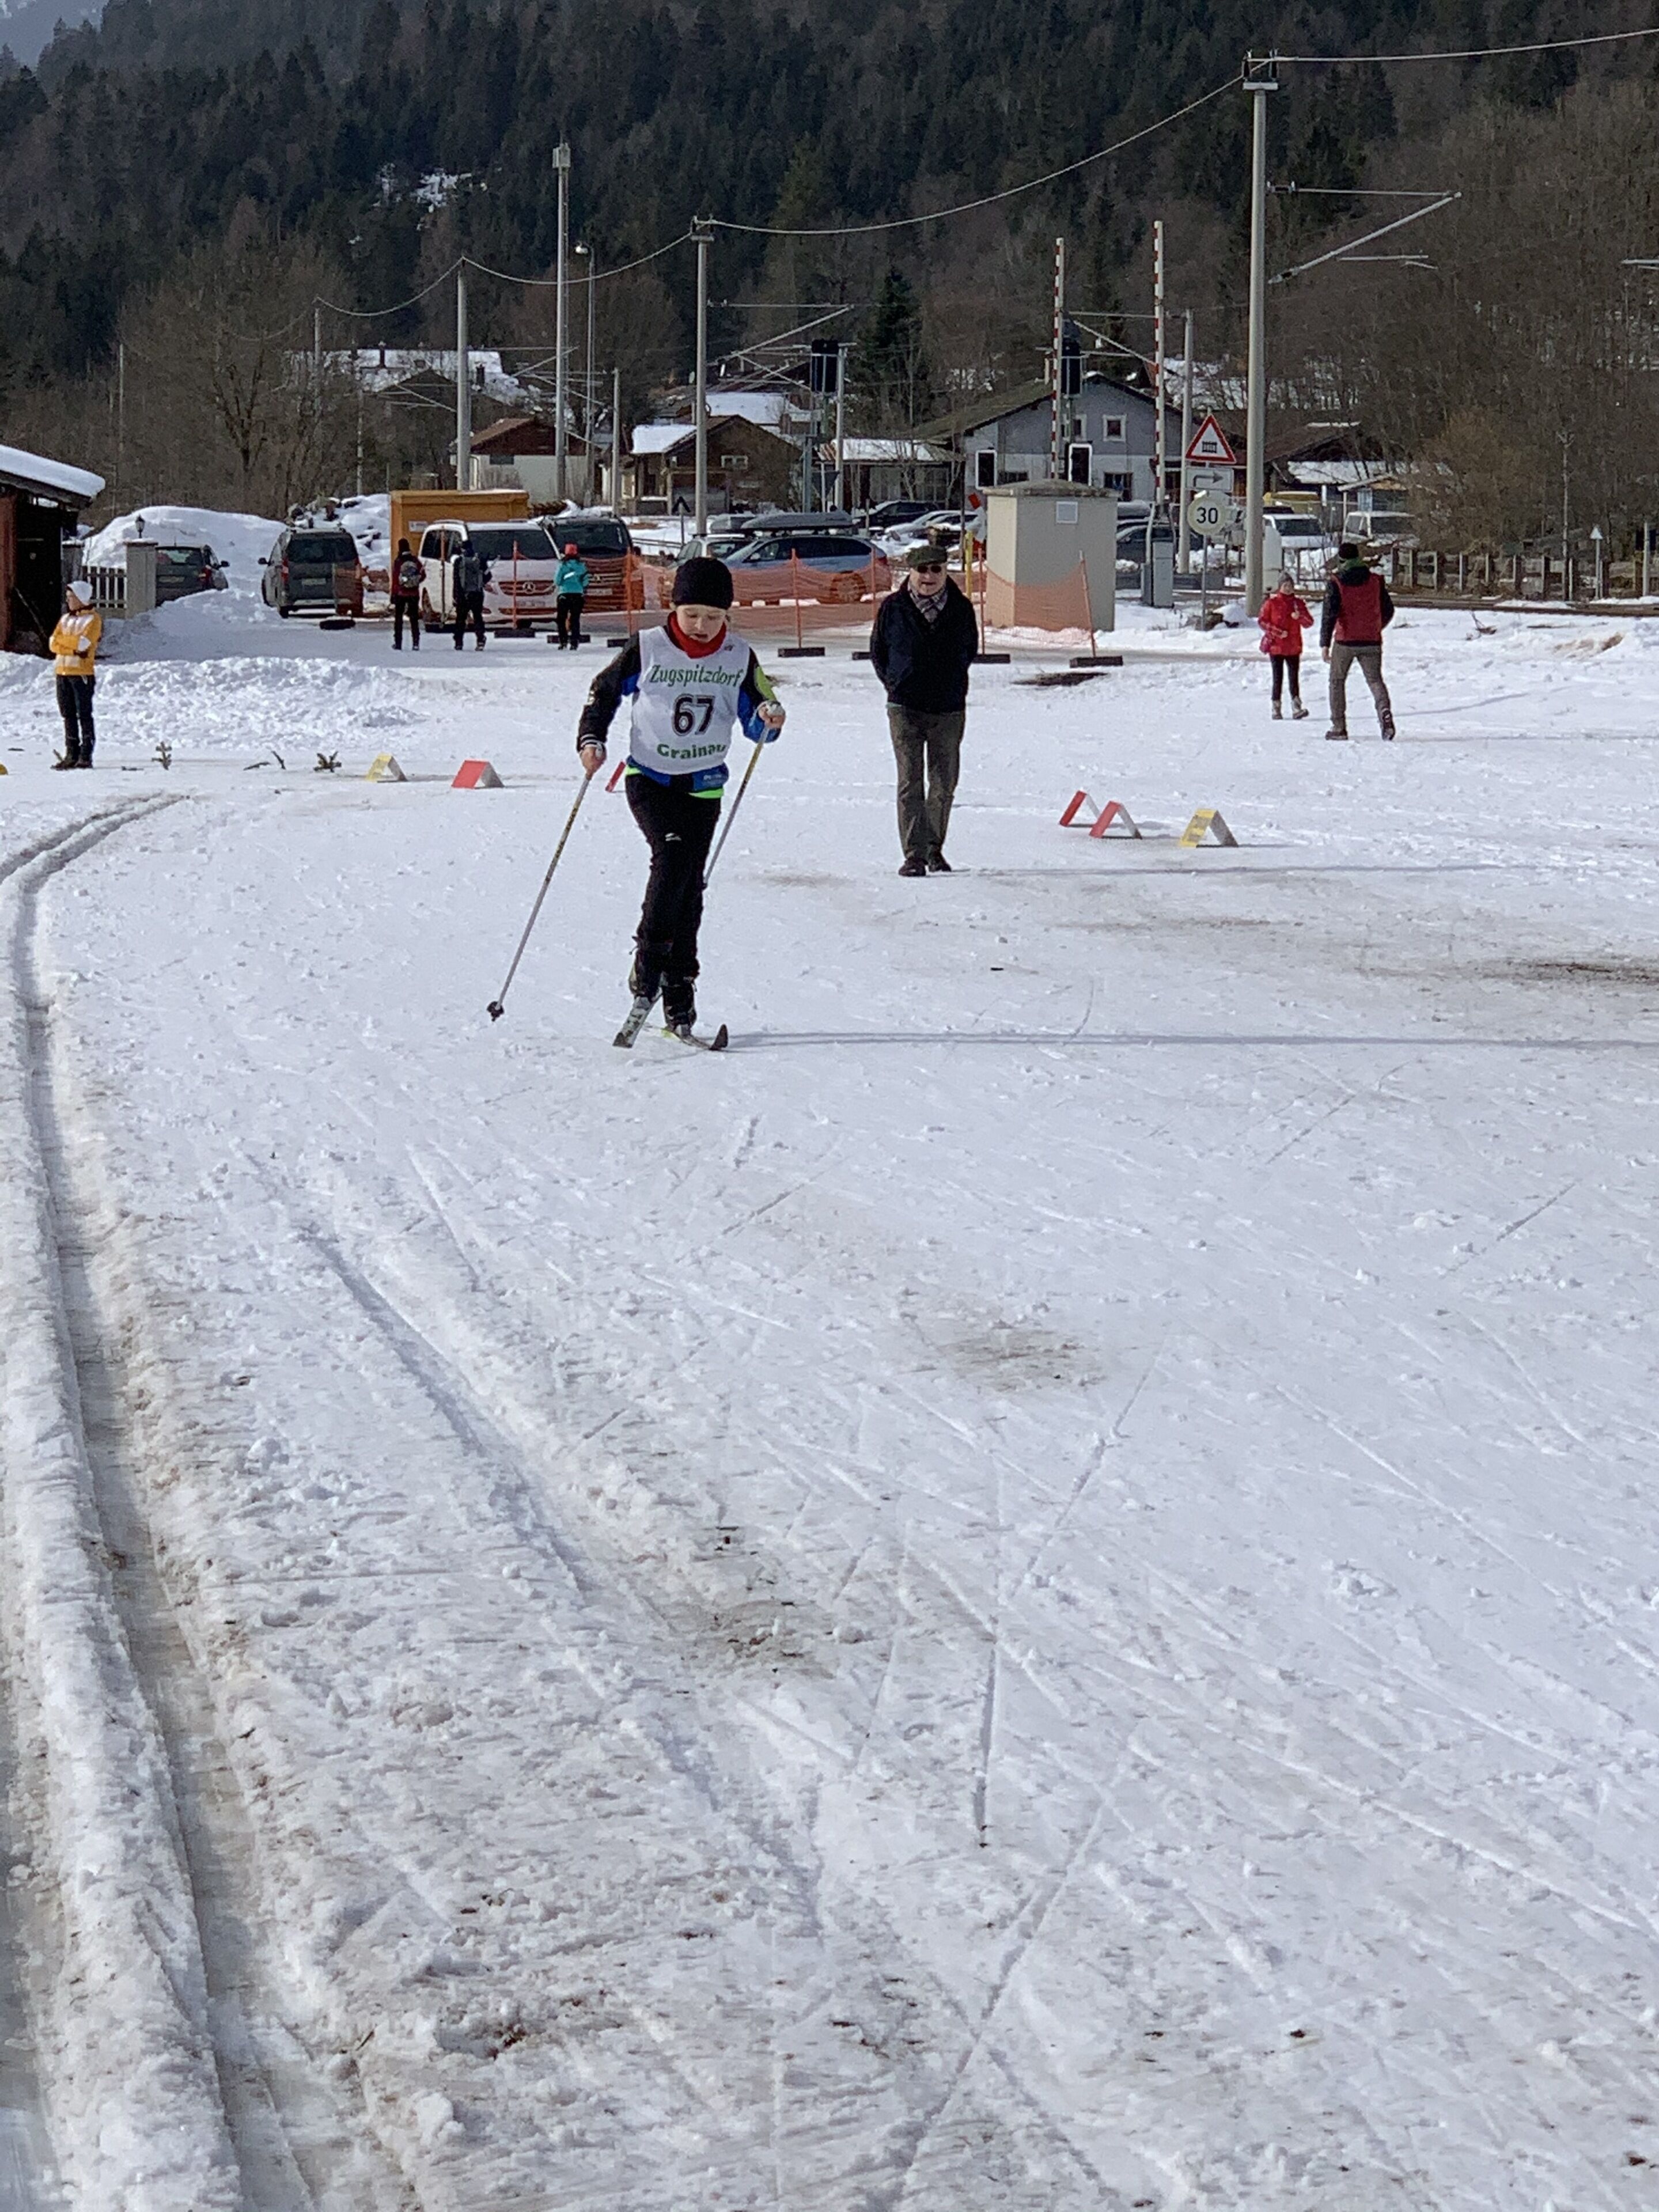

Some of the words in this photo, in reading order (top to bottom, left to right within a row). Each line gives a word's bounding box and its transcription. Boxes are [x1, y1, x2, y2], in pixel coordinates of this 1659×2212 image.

[1196, 507, 1218, 524] 30
[650, 664, 744, 687] Zugspitzdorf
[672, 693, 715, 736] 67
[657, 744, 726, 759] Grainau
